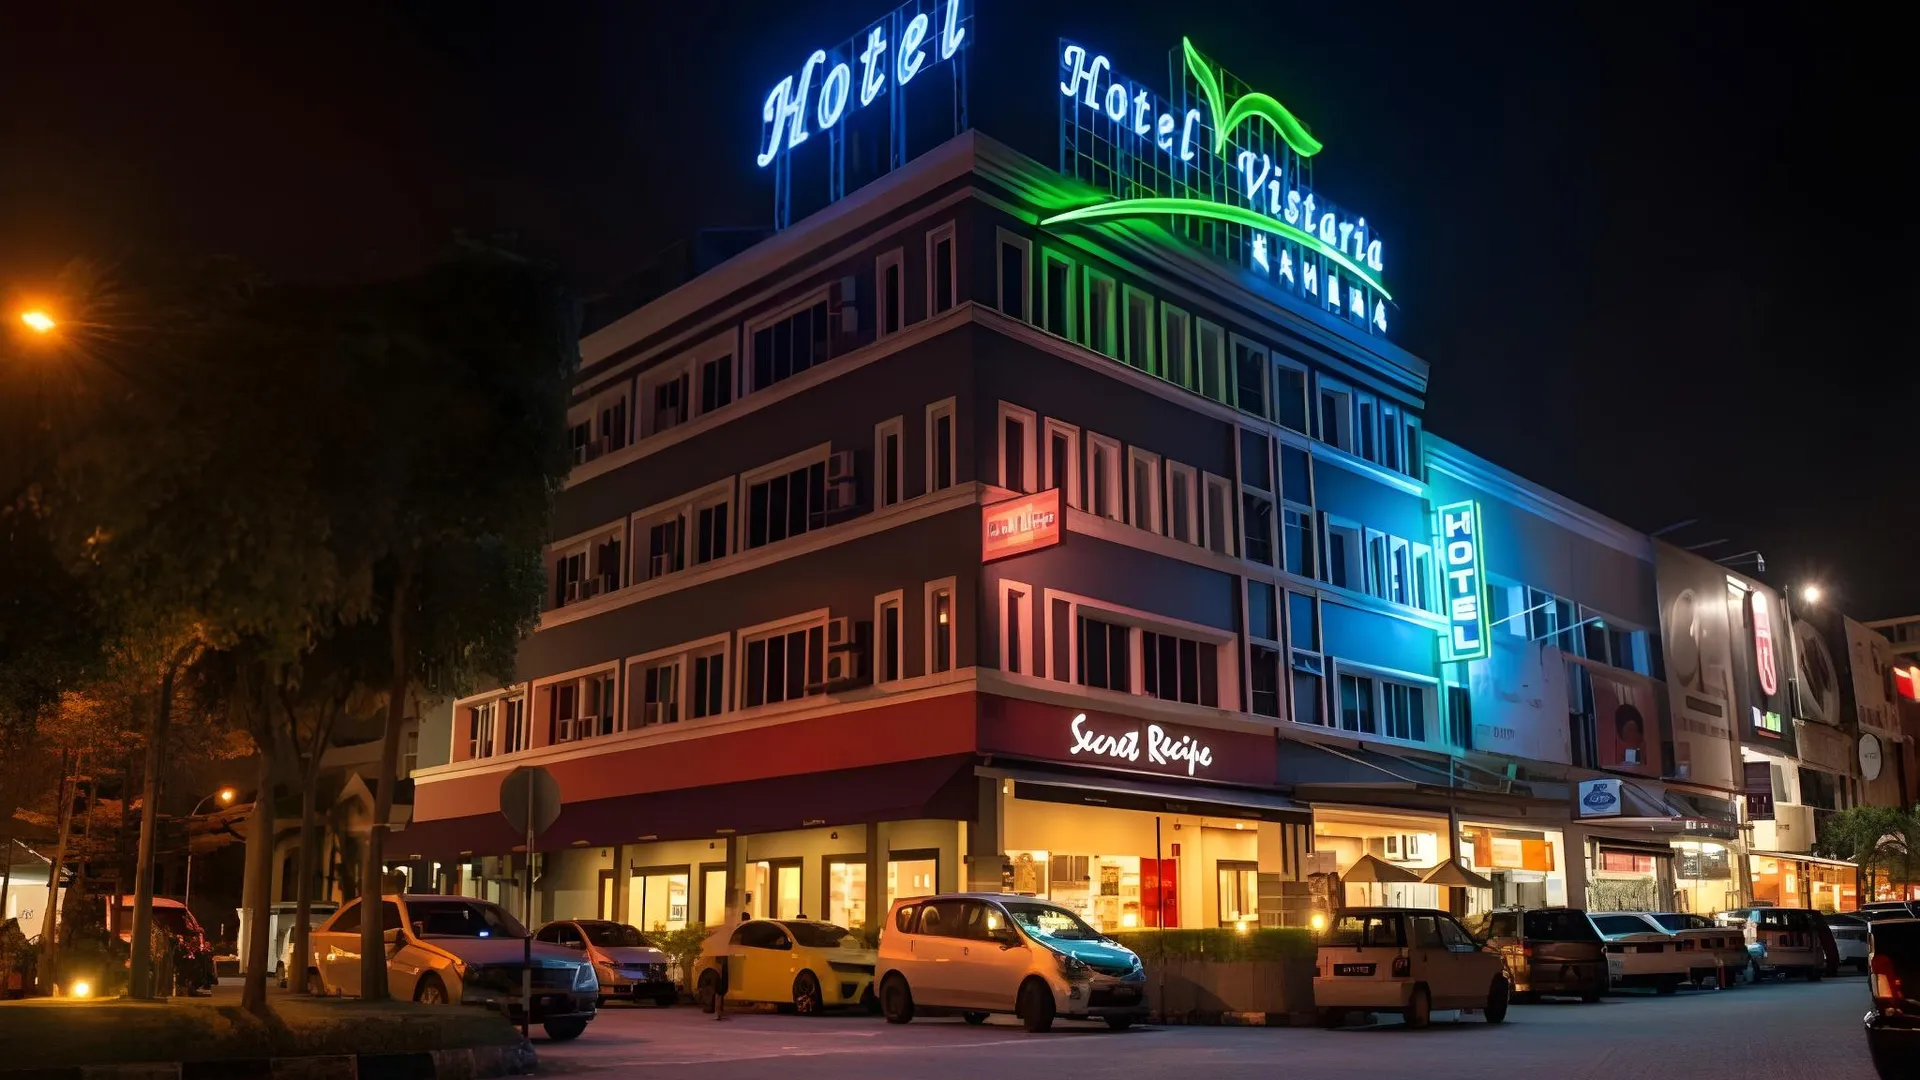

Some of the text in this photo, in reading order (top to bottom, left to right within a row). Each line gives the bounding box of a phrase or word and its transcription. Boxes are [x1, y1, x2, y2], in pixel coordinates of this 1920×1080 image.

[757, 0, 965, 167] Hotel
[1060, 45, 1200, 161] Hotel
[1238, 151, 1383, 271] Vistaria
[1445, 511, 1480, 650] HOTEL
[1070, 713, 1213, 776] Secret Recipe
